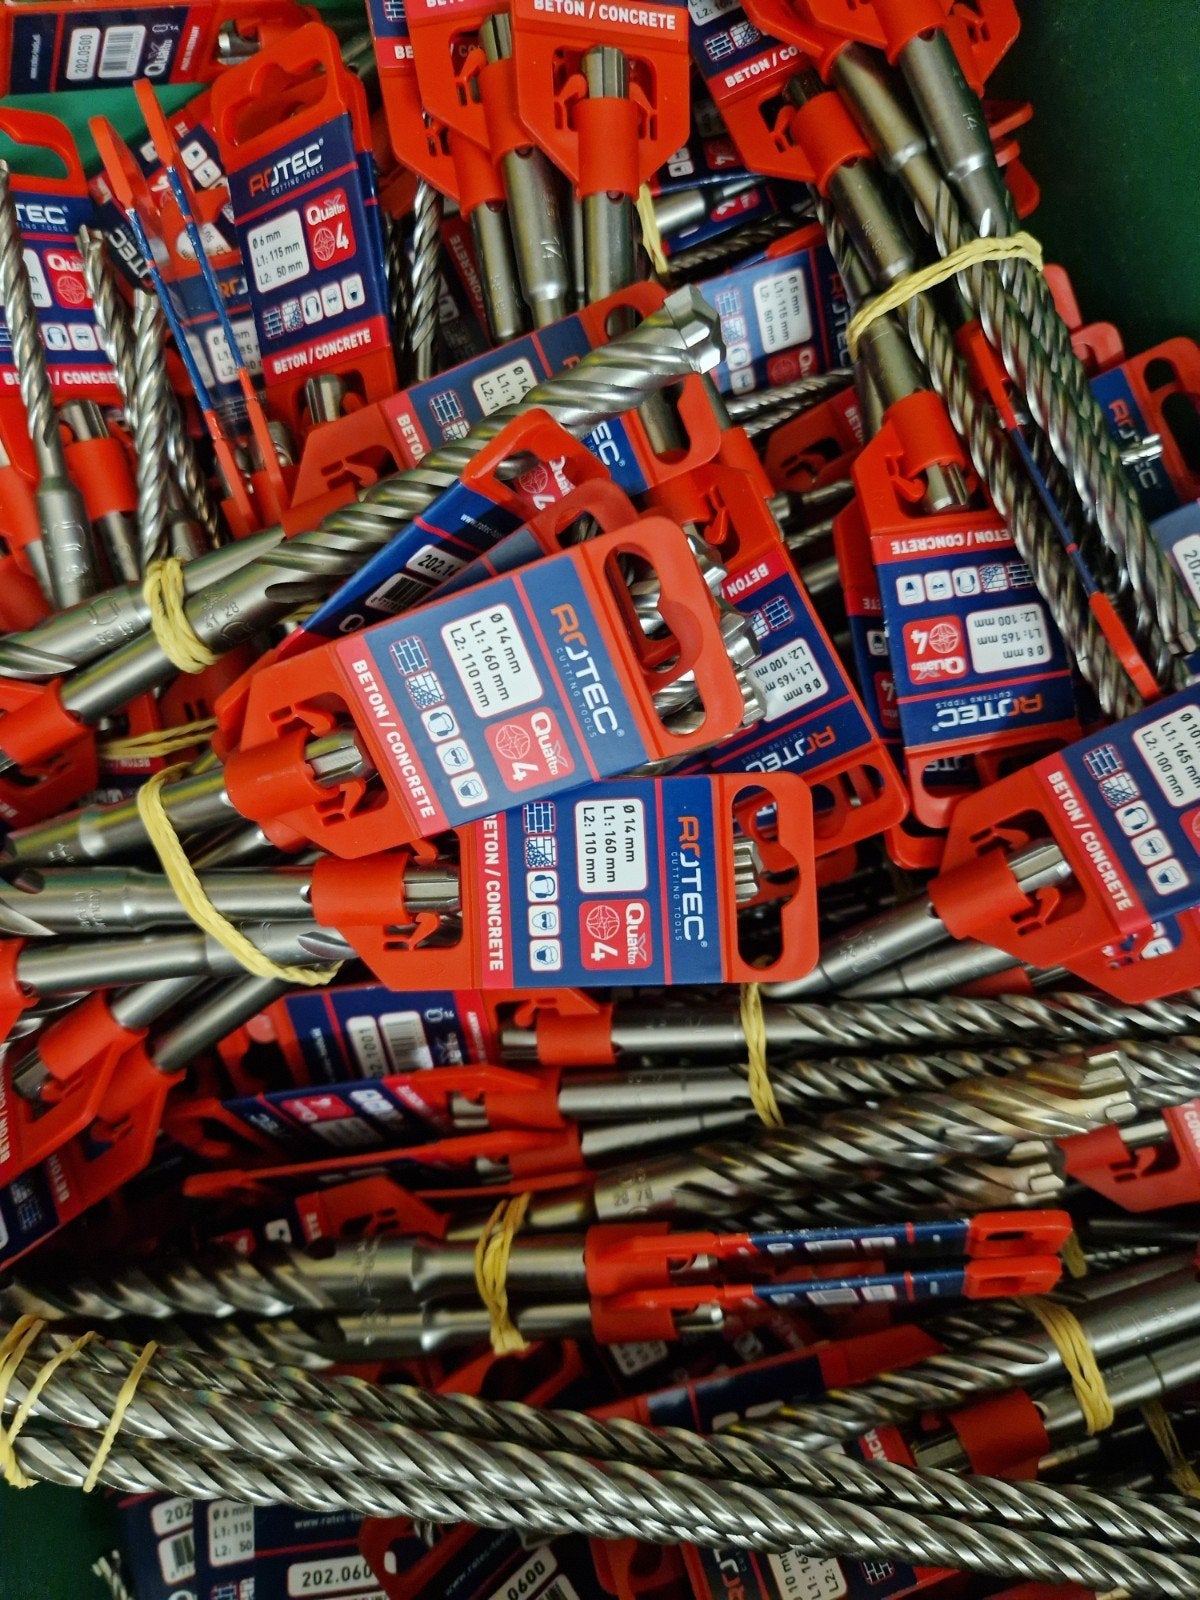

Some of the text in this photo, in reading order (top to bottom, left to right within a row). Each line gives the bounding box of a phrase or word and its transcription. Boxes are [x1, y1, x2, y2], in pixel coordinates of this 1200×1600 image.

[534, 0, 584, 17] BETON
[599, 4, 676, 30] CONCRETE
[75, 34, 92, 73] 202.0500
[725, 57, 771, 88] BETON
[15, 203, 66, 225] TEC
[259, 237, 265, 246] 6
[265, 229, 281, 242] mm
[335, 222, 350, 249] 4
[110, 226, 152, 279] TEC
[270, 246, 284, 261] 115
[284, 239, 301, 255] mm
[276, 264, 287, 278] 50
[287, 259, 304, 273] mm
[790, 293, 801, 317] mm
[767, 327, 777, 346] mm
[781, 322, 791, 342] mm
[272, 348, 307, 375] BETON
[314, 327, 372, 360] CONCRETE
[890, 533, 964, 554] CONCRETE
[975, 529, 1011, 543] ETON
[418, 554, 457, 577] 202.1
[727, 562, 770, 598] BETON
[974, 610, 1039, 628] L2: 100 mm
[490, 612, 521, 674] Ø 14 mm
[910, 629, 929, 655] 4
[977, 635, 998, 646] mm
[1000, 631, 1021, 642] 165
[470, 620, 510, 701] L1: 160 mm
[770, 655, 788, 673] 100
[791, 645, 806, 661] L2:
[1003, 649, 1024, 659] mm
[1027, 647, 1034, 656] 8
[450, 627, 490, 708] L2: 110 mm
[550, 603, 619, 735] ROTEC
[779, 670, 797, 689] 165
[795, 662, 815, 677] L1:
[556, 646, 598, 738] CUTTING TOOLS
[783, 677, 822, 703] Ø 8 mm
[351, 658, 390, 719] BETON
[386, 731, 436, 819] CONCRETE
[1180, 713, 1200, 739] Ø 10
[1160, 721, 1177, 743] L1:
[1172, 742, 1193, 766] 165
[511, 761, 540, 781] 4
[1141, 730, 1185, 798] L2: 100 mm
[583, 806, 597, 884] L2: 110 mm
[603, 805, 617, 883] L1: 160 mm
[622, 804, 636, 863] Ø 14 mm
[1047, 771, 1135, 912] BETON / CONCRETE
[484, 868, 502, 877] /
[677, 816, 705, 941] ROTEC
[671, 851, 683, 941] CUTTING TOOLS
[486, 879, 505, 972] CONCRETE
[590, 941, 619, 962] 4
[214, 1522, 253, 1540] L1: 115
[239, 1540, 253, 1552] 50
[302, 1565, 372, 1588] 202.060
[508, 1560, 545, 1600] 0600
